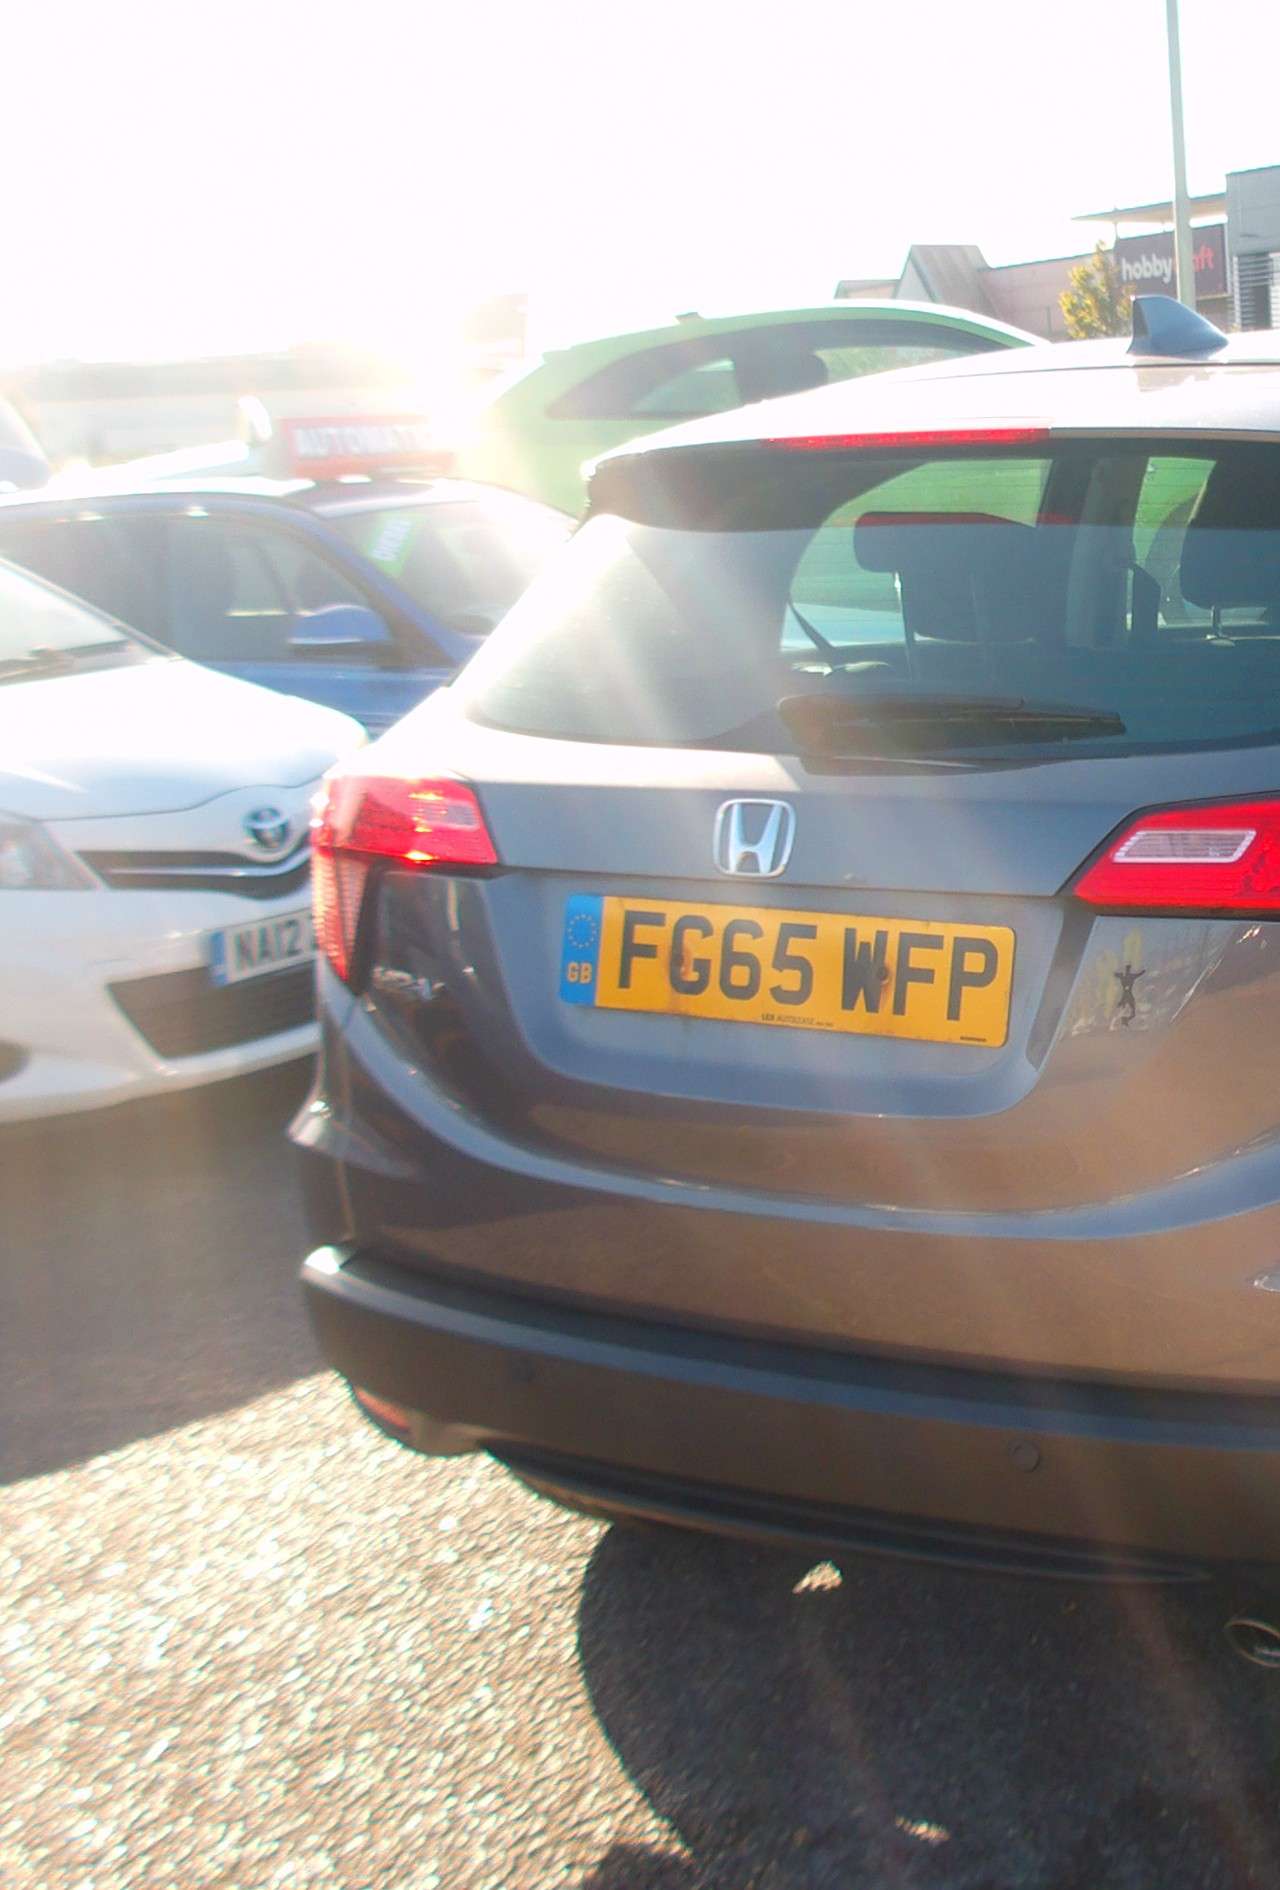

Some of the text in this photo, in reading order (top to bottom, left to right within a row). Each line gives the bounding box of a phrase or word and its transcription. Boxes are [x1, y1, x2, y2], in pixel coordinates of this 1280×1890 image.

[566, 961, 593, 984] GB
[617, 910, 1001, 1022] FG65 WFP
